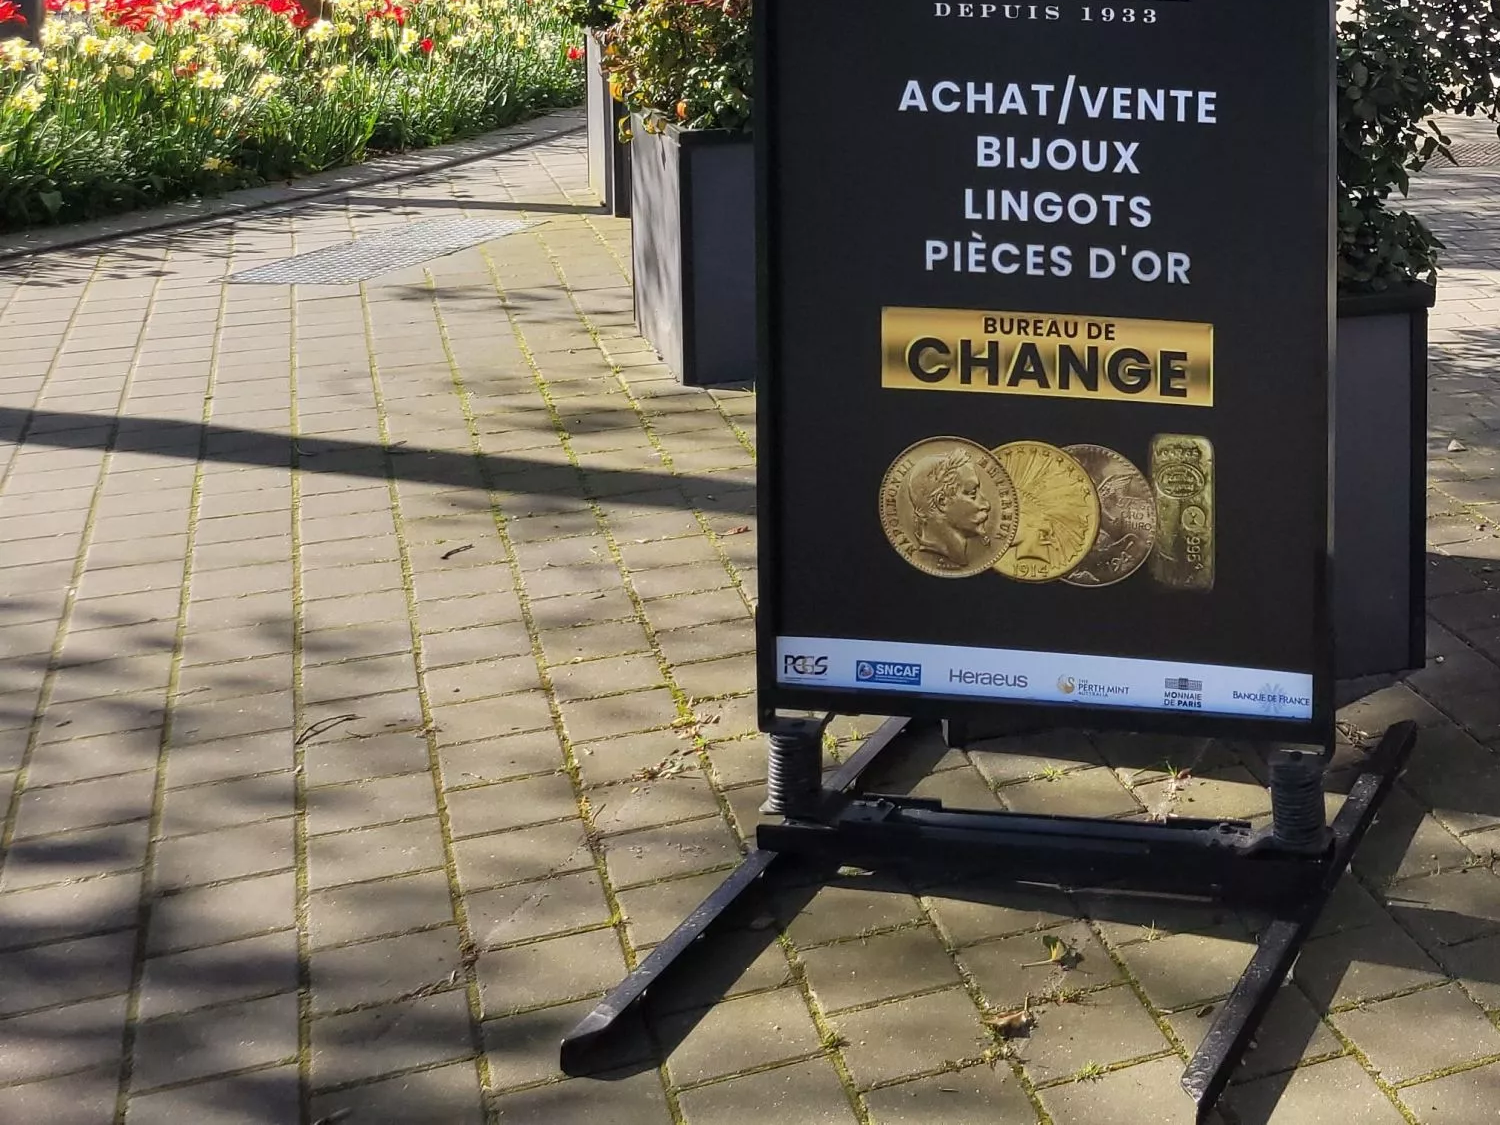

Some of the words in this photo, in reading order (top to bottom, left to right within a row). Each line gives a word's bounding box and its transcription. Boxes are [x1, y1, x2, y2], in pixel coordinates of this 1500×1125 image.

[934, 1, 1061, 22] DEPUIS
[1080, 6, 1159, 25] 1933
[898, 74, 1218, 125] ACHAT/VENTE
[976, 135, 1140, 175] BIJOUX
[964, 188, 1152, 229] LINGOTS
[924, 231, 1073, 276] PIÈCES
[1088, 245, 1192, 285] D'OR
[983, 316, 1079, 339] BUREAU
[1086, 322, 1116, 341] DE
[904, 337, 1189, 398] CHANGE
[1013, 564, 1049, 578] 1914
[875, 663, 921, 679] SNCAF
[949, 668, 1029, 688] Heraeus
[1078, 683, 1105, 693] PERTH
[1107, 686, 1130, 695] MINT
[1164, 691, 1202, 701] MONNAIE
[1232, 691, 1265, 702] BANQUE
[1267, 695, 1277, 703] DE
[1279, 695, 1310, 707] FRANCE
[1164, 699, 1175, 707] DE
[1177, 700, 1202, 709] PARIS
